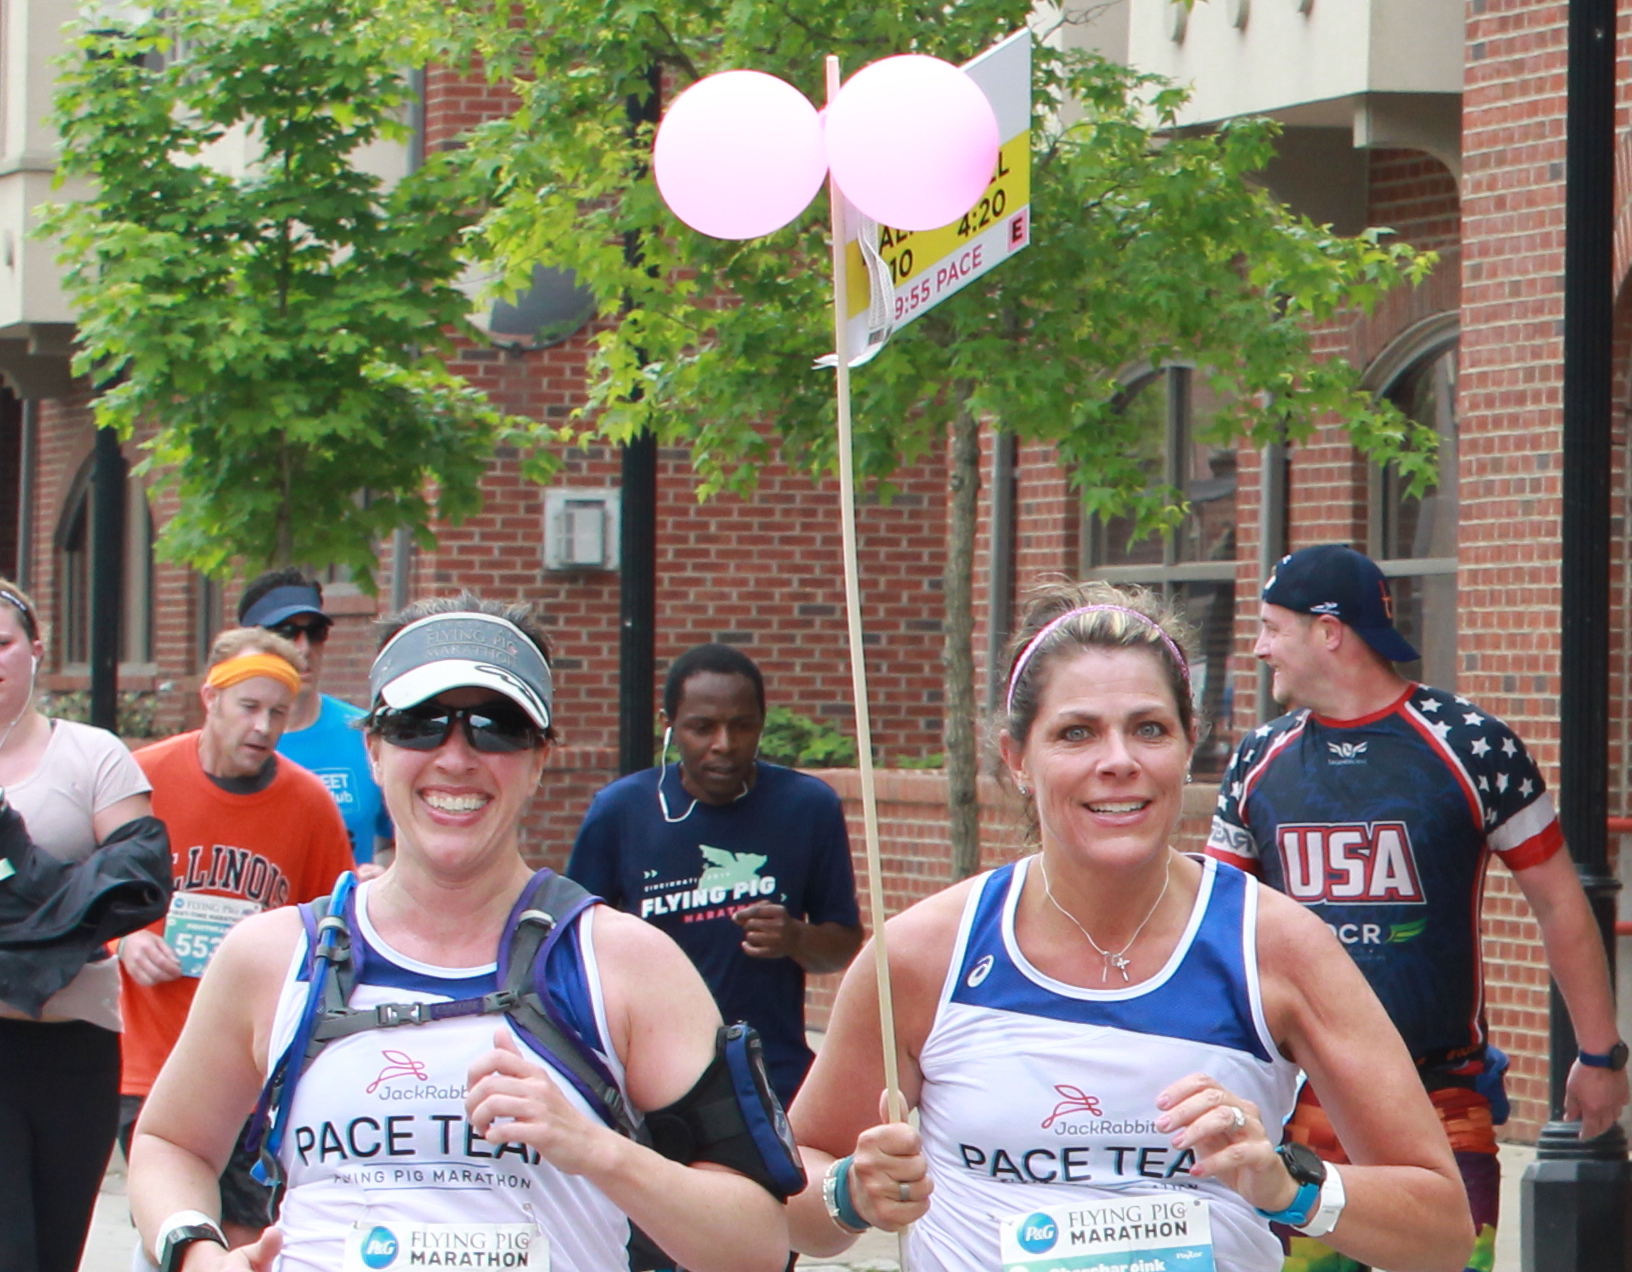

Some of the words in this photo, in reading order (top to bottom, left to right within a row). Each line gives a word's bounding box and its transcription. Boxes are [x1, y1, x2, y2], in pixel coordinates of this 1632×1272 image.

[957, 189, 1007, 238] 4:20
[1011, 217, 1024, 243] E
[894, 279, 931, 321] 9:55
[937, 244, 983, 292] PACE
[426, 628, 486, 645] FLYING
[173, 845, 290, 908] LINOIS
[1277, 821, 1427, 905] USA
[641, 886, 727, 919] FLYING
[733, 876, 776, 900] PIG
[378, 1085, 470, 1102] JackRabb
[294, 1114, 417, 1167] PACE
[429, 1114, 543, 1166] TEA
[1054, 1120, 1157, 1136] JackRabbit
[959, 1143, 1092, 1182] PACE
[1103, 1146, 1197, 1179] TEA
[395, 1170, 425, 1183] PIG
[432, 1169, 532, 1189] MARATHON
[1025, 1224, 1055, 1242] P&G
[1068, 1205, 1142, 1228] FLYING
[1152, 1202, 1187, 1221] PIG
[1071, 1220, 1188, 1246] MARATHON
[365, 1239, 395, 1256] P&G
[411, 1231, 486, 1250] FLYING
[496, 1232, 530, 1250] PIG
[410, 1251, 530, 1268] MARATHON
